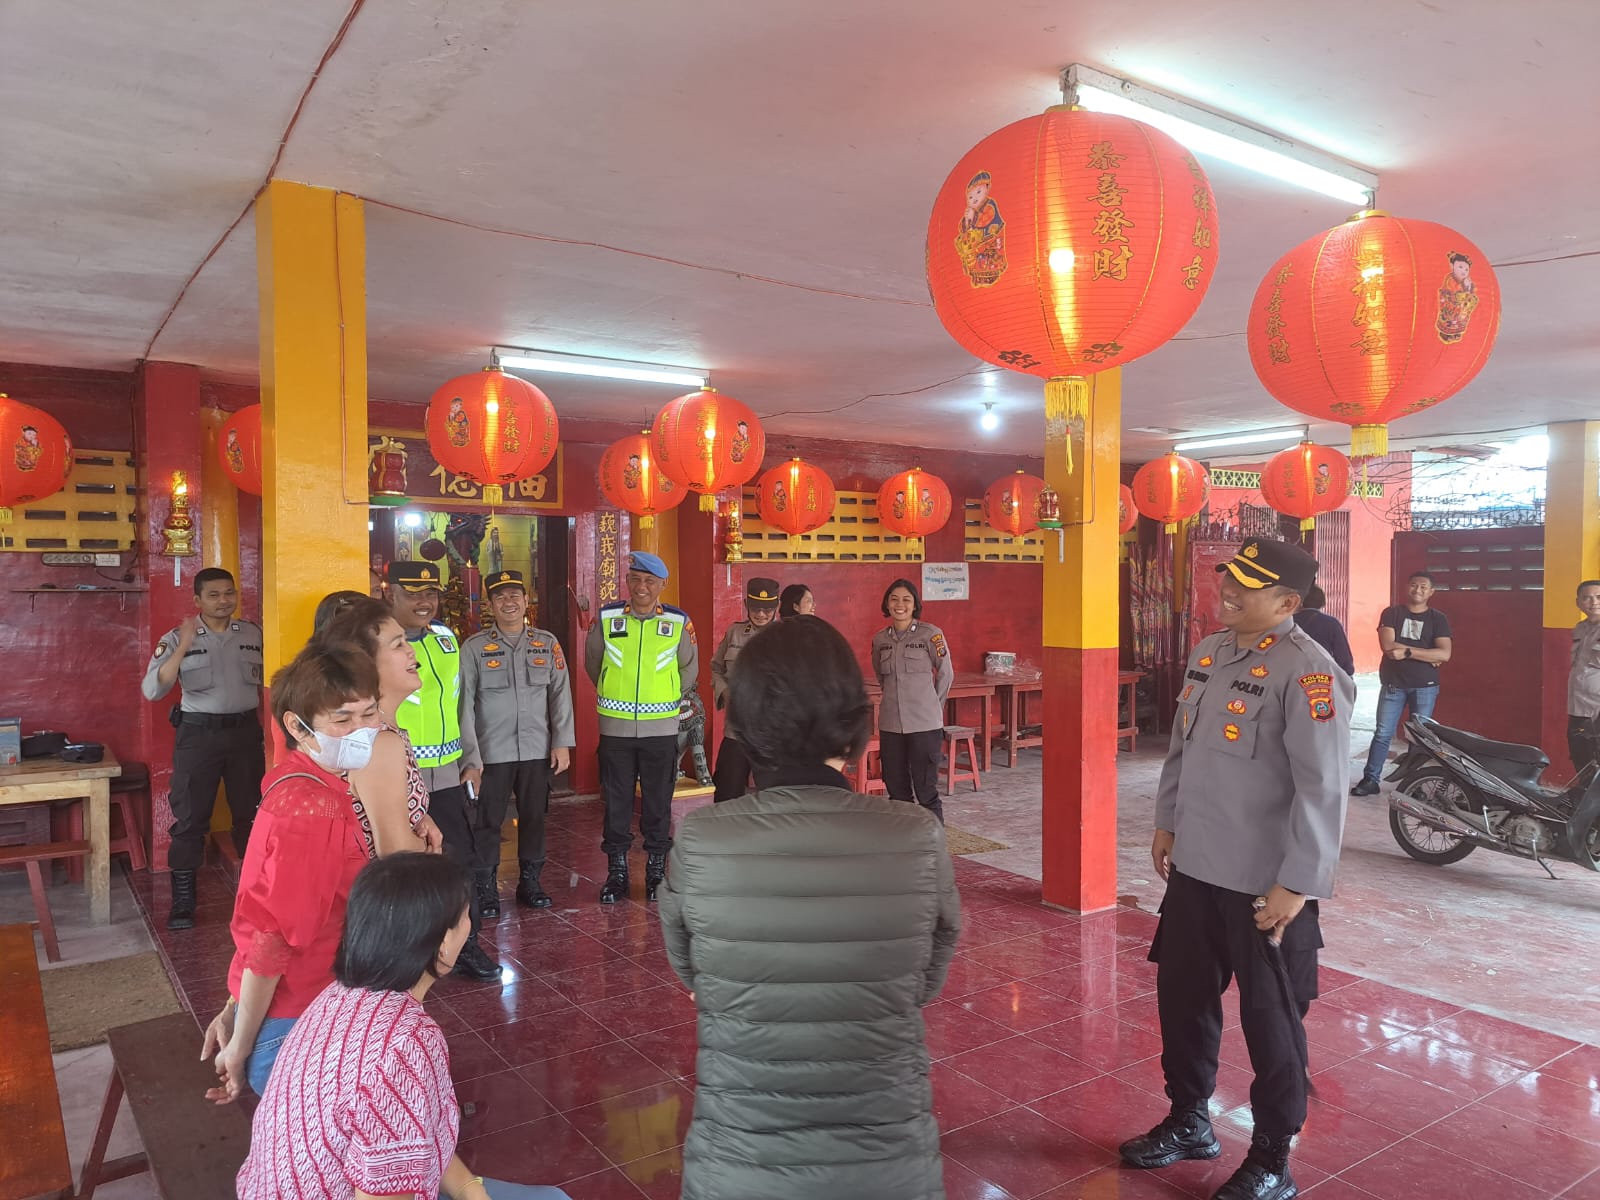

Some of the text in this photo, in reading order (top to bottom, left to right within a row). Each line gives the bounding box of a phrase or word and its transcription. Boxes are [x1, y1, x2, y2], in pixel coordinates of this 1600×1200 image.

[1087, 141, 1135, 281] 恭喜發財
[1231, 680, 1264, 696] POLRI
